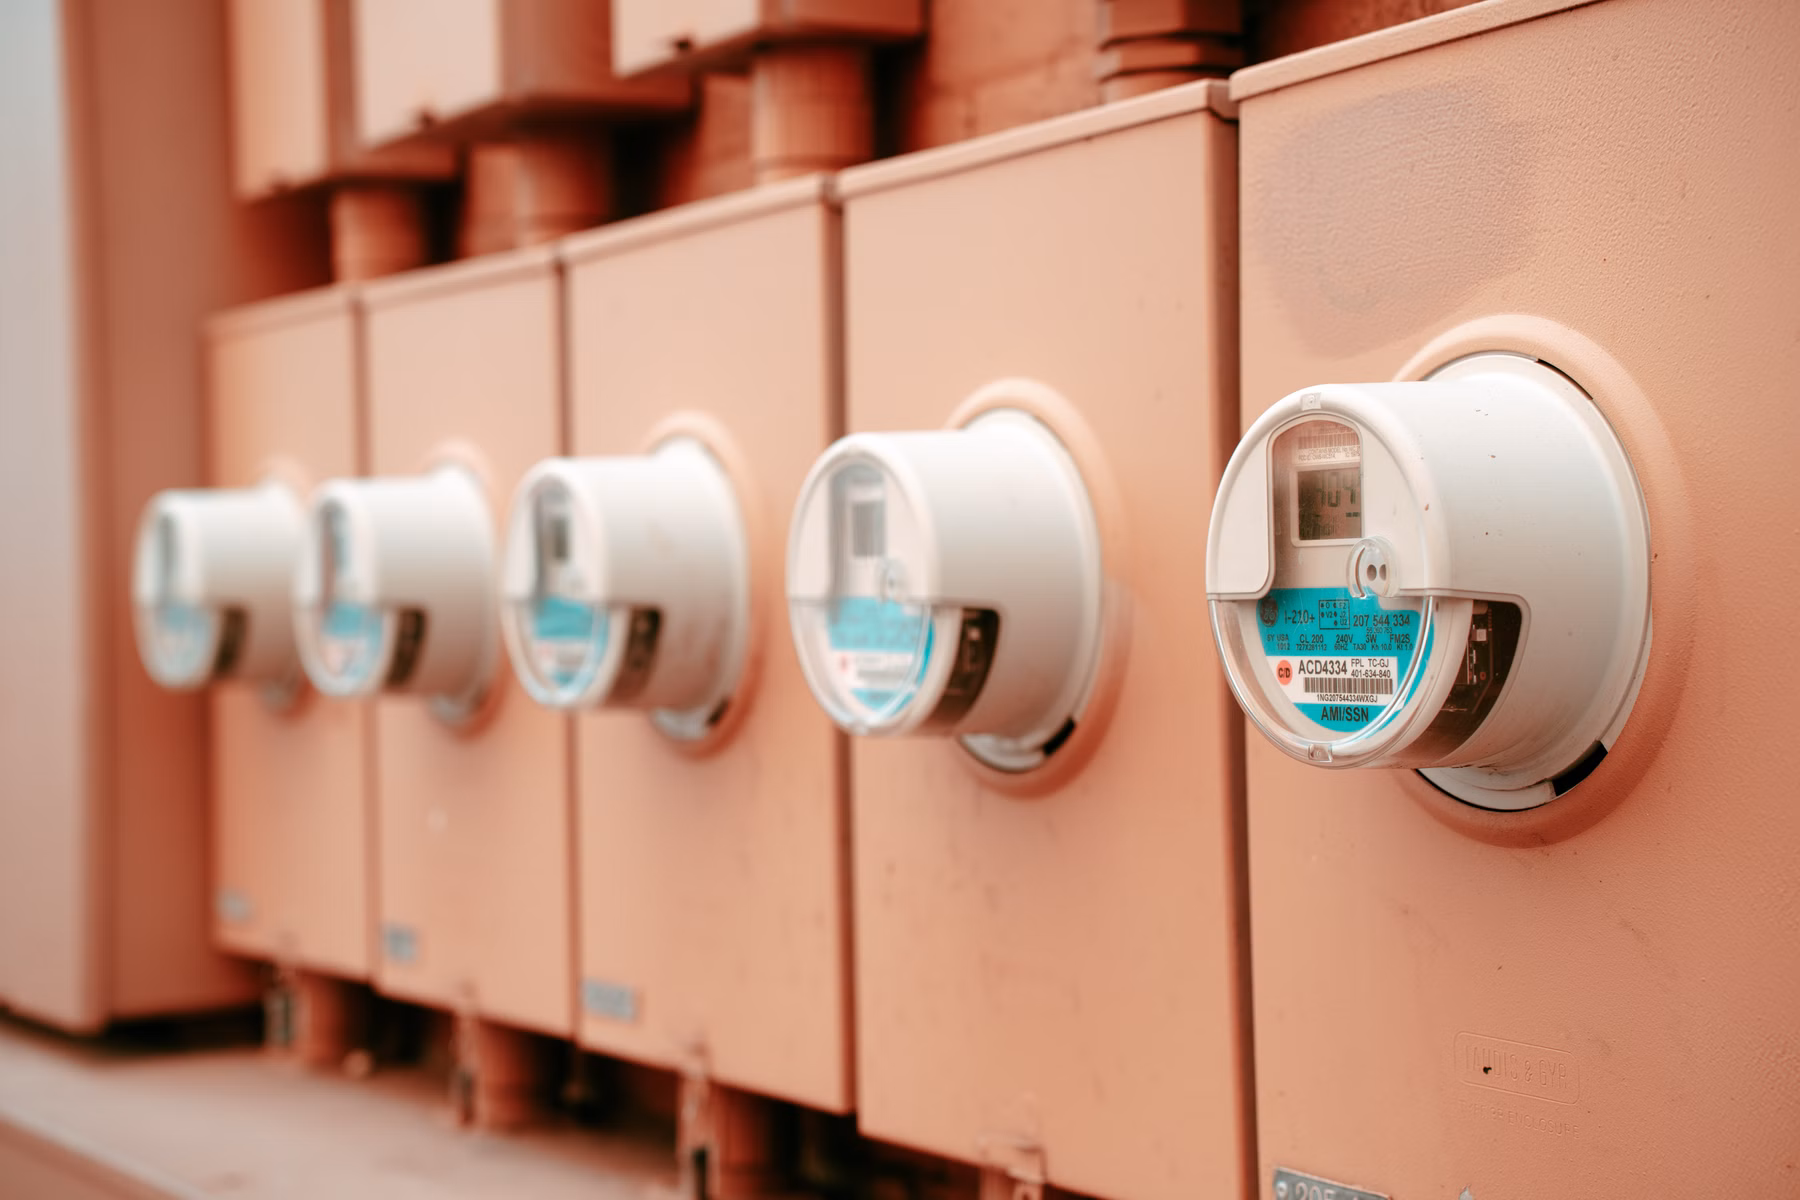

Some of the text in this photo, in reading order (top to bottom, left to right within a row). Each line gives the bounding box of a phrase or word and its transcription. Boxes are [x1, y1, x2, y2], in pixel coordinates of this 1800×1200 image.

[1284, 609, 1315, 625] I-210+
[1353, 613, 1411, 627] 207 544 334
[1276, 633, 1289, 642] USA
[1299, 633, 1411, 644] CL 200 240V 3W FM2S
[1352, 643, 1367, 651] TA30
[1298, 659, 1348, 675] ACD4334
[1351, 658, 1389, 668] FPL TC-GJ
[1278, 667, 1291, 679] C/D
[1351, 669, 1391, 679] 401-634-840
[1316, 693, 1378, 703] 1NG207544334WXGJ
[1320, 705, 1369, 723] AMI/SSN
[1507, 1110, 1581, 1139] ENCLOSURE
